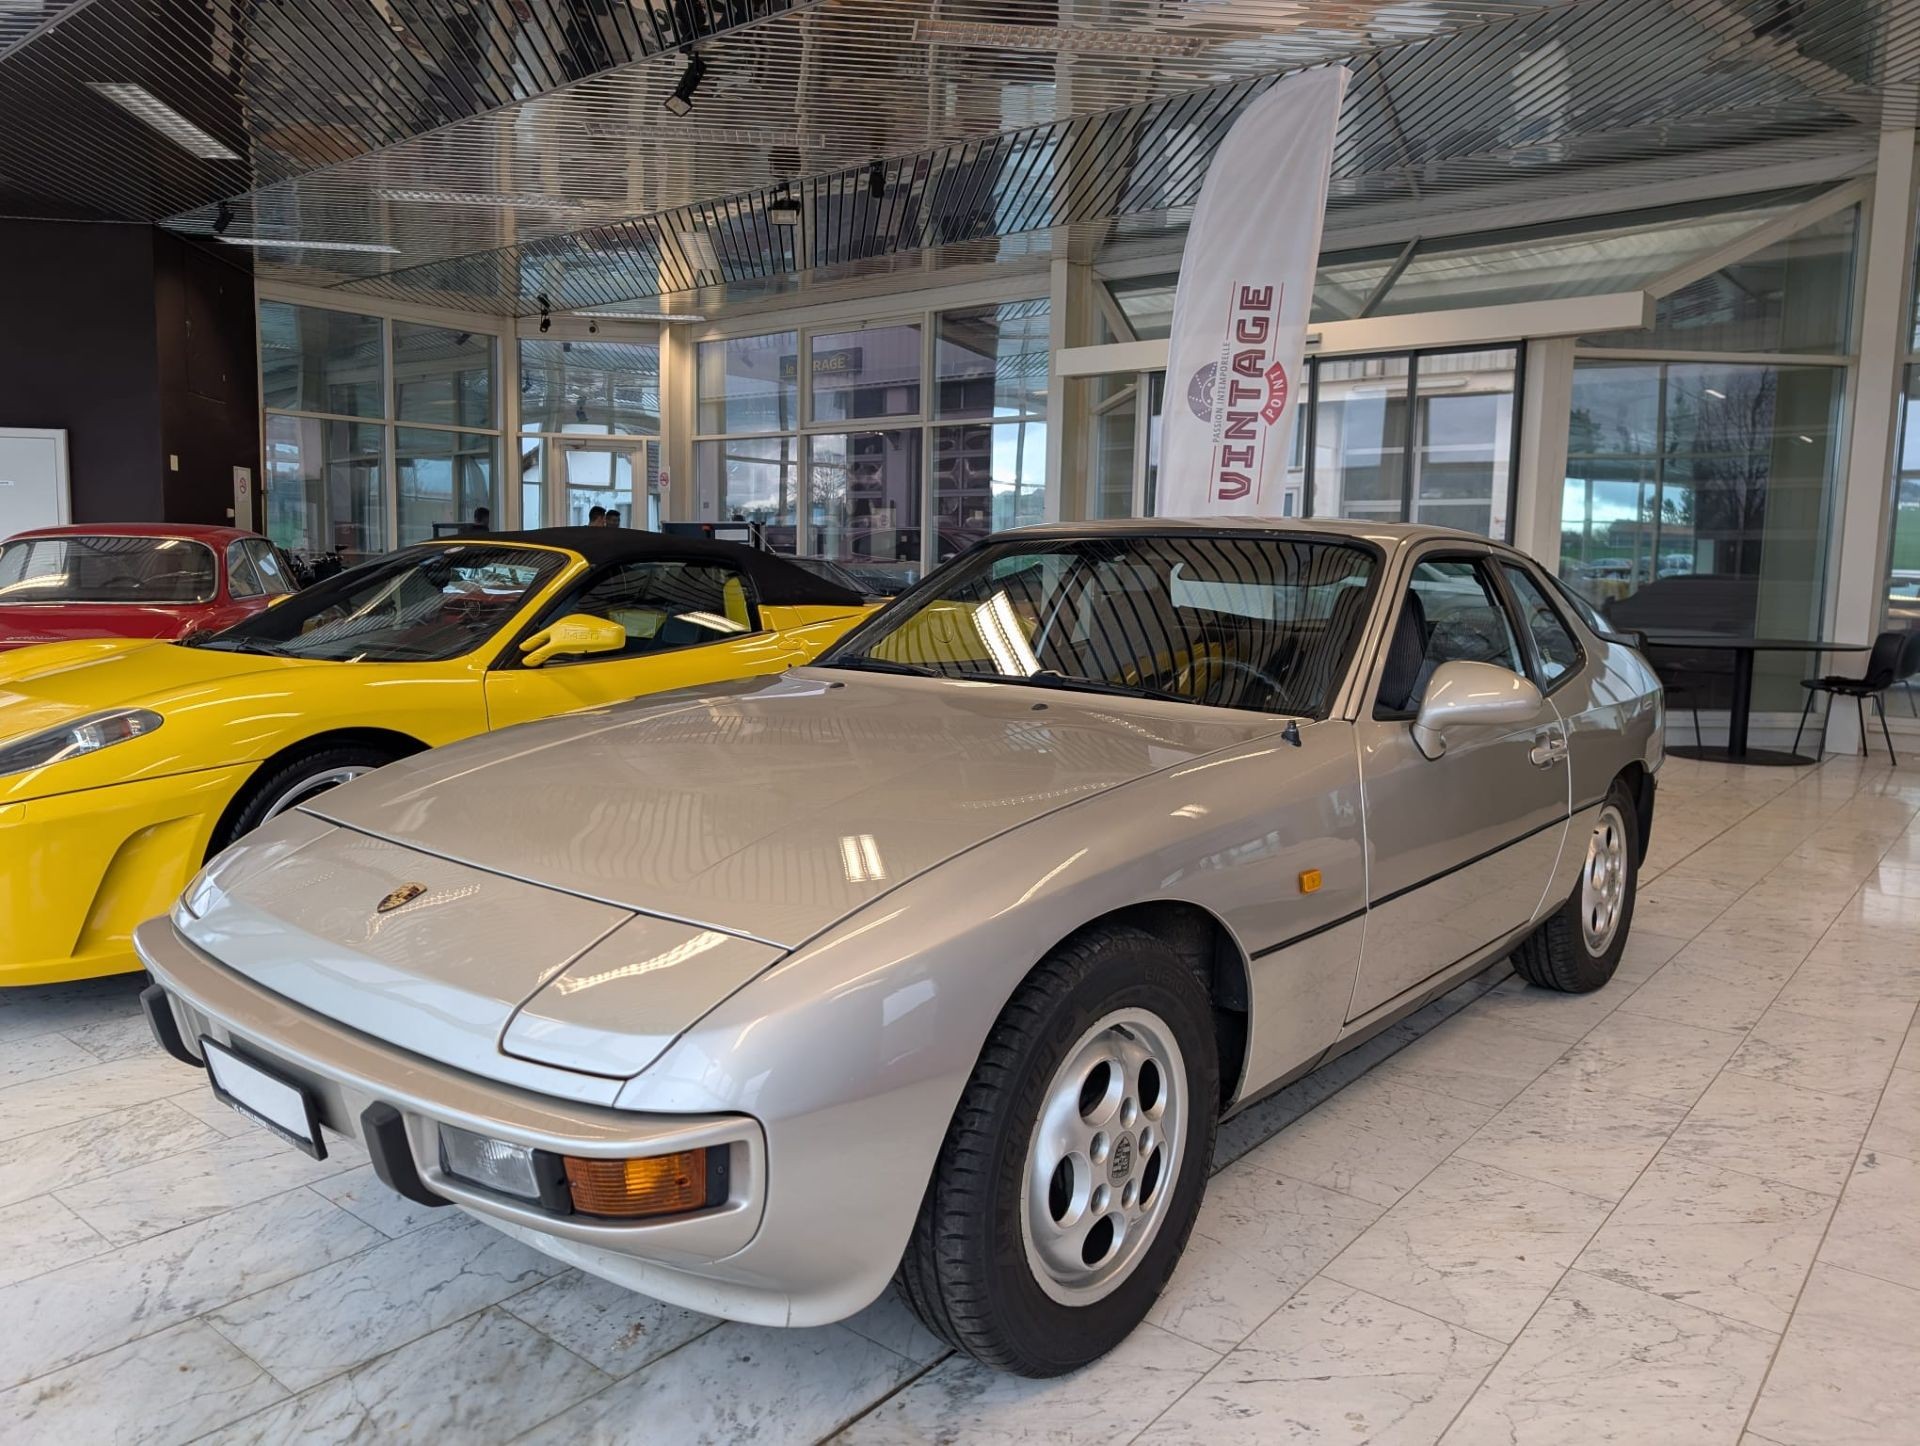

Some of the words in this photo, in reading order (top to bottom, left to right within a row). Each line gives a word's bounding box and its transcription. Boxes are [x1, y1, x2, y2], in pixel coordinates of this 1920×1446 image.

[813, 357, 846, 371] RAGE
[1215, 341, 1231, 404] INTEMPORELLE
[1218, 285, 1273, 500] VINTAGE
[1265, 371, 1284, 419] POINT
[1212, 406, 1223, 443] PASSION
